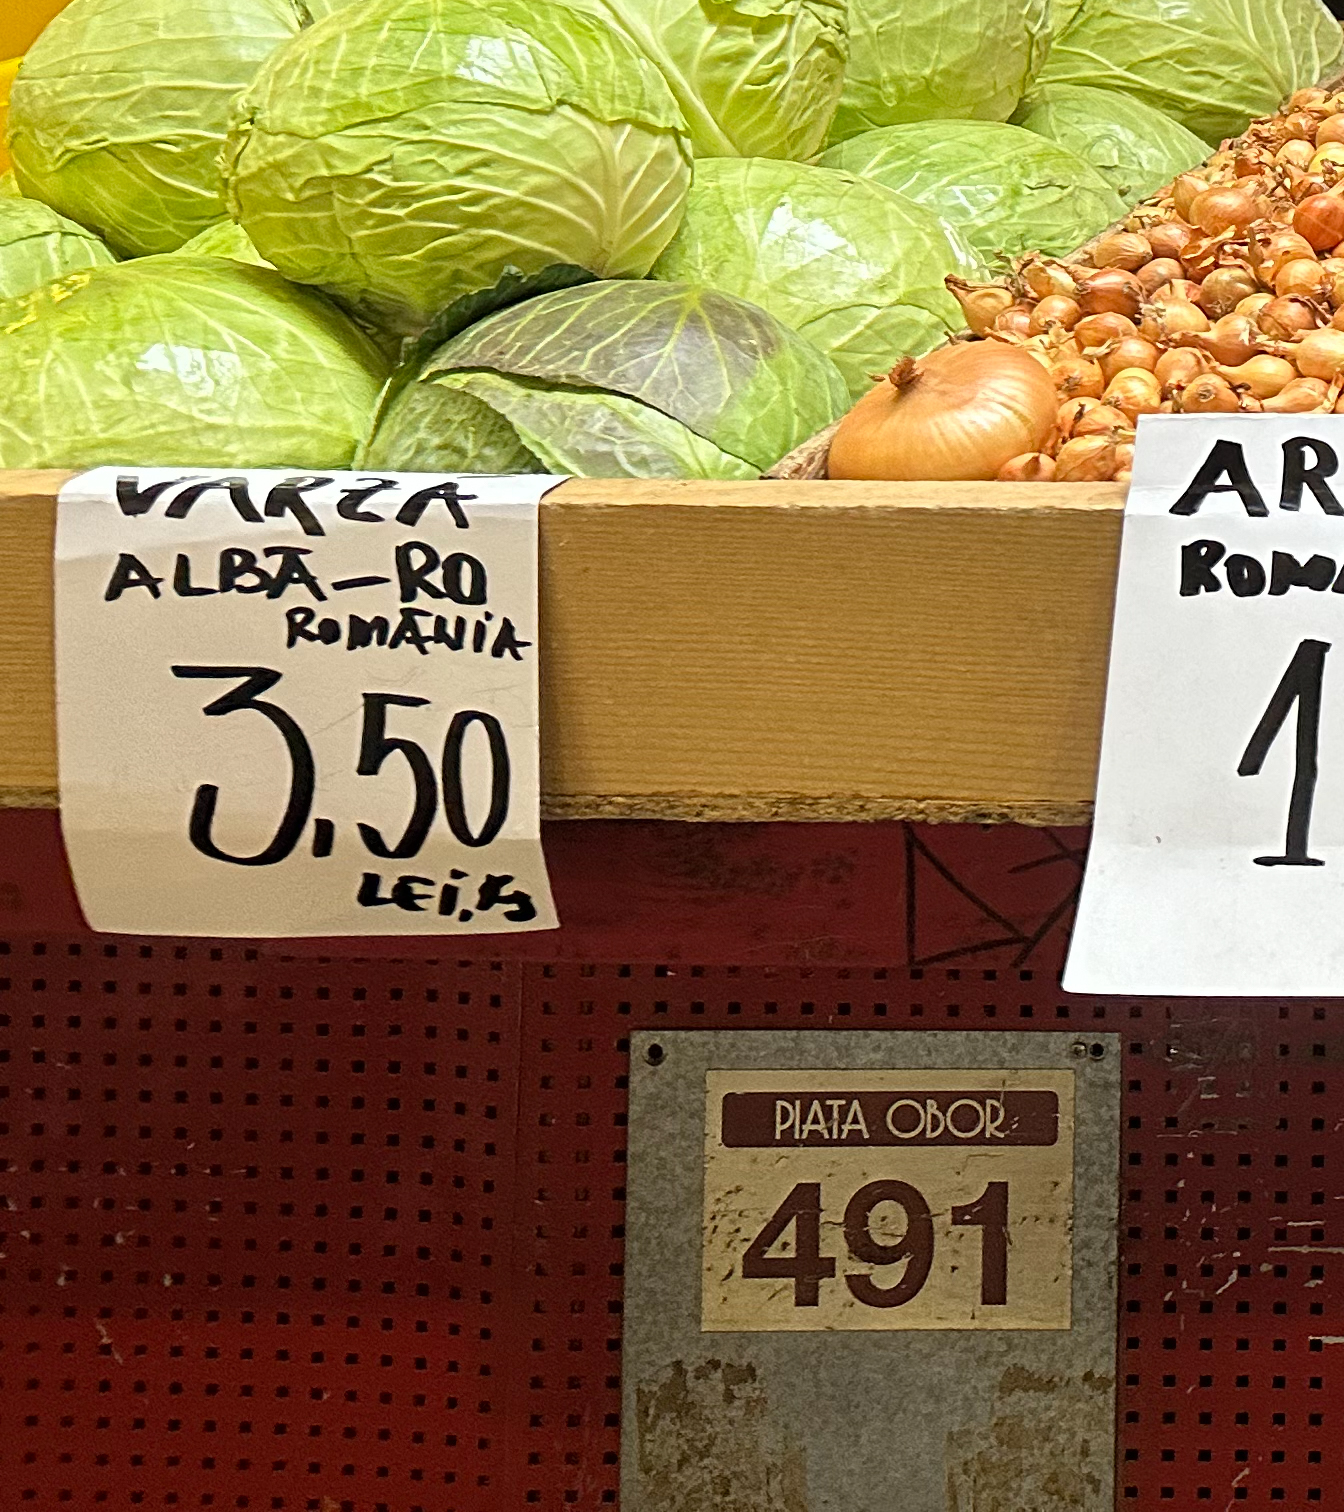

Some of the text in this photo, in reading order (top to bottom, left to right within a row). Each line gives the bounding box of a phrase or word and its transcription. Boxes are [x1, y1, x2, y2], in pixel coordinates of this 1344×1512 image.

[171, 665, 510, 866] 3,50
[774, 1098, 1006, 1140] PIATA OBOR
[741, 1179, 1010, 1309] 491
